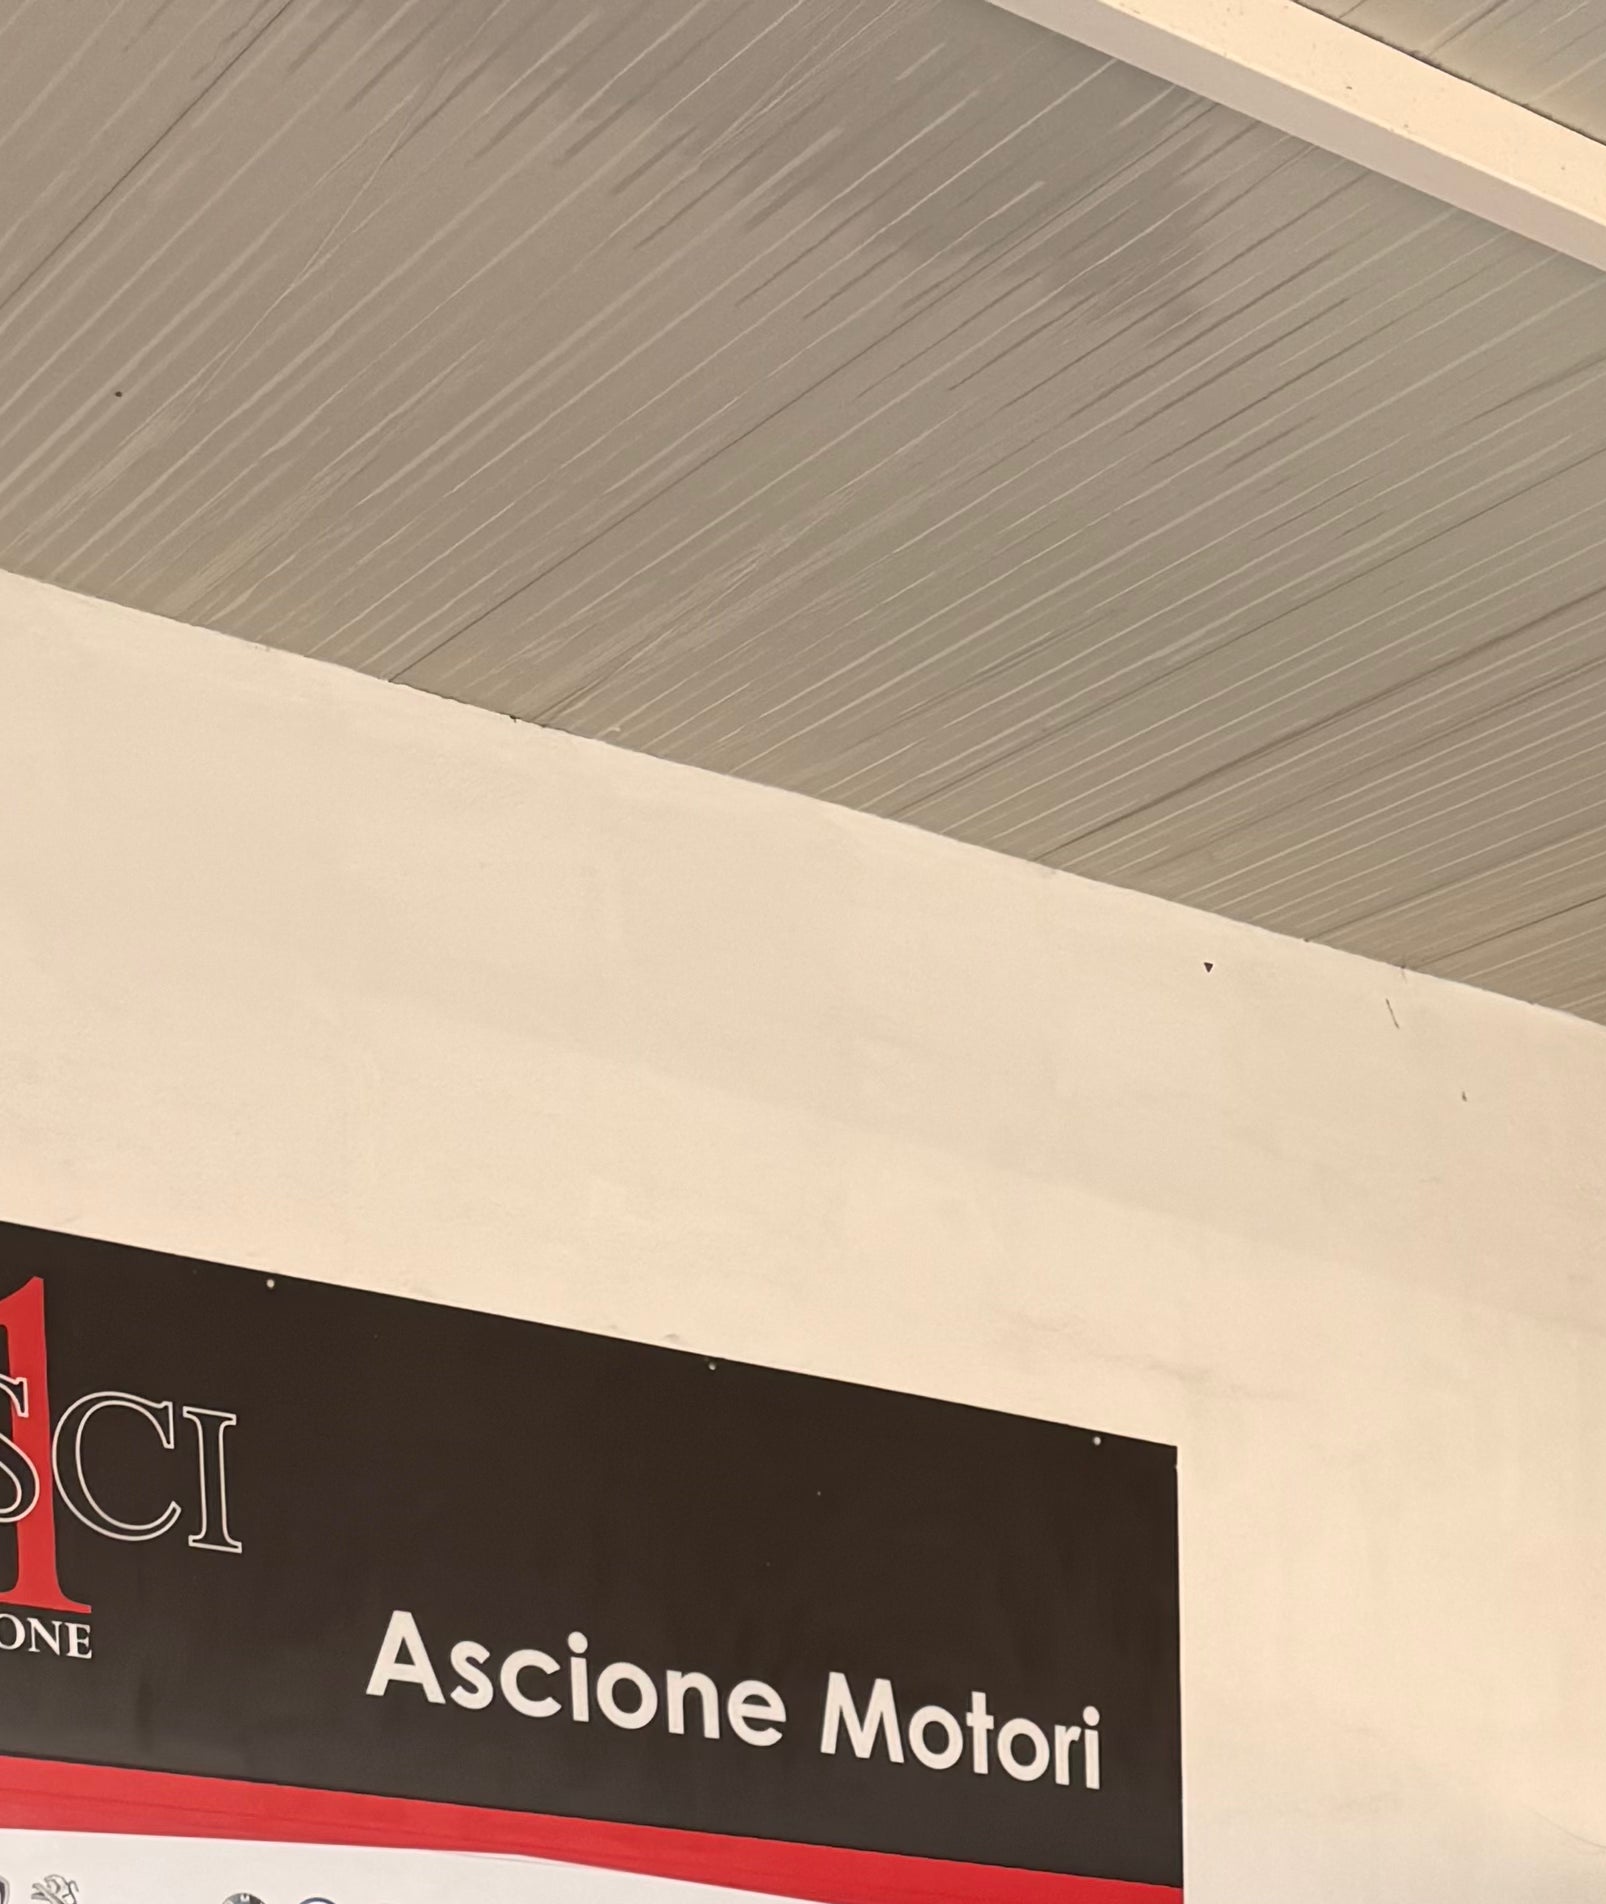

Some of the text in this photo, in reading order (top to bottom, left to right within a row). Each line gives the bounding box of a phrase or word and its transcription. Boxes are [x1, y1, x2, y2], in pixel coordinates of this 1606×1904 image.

[0, 1613, 92, 1659] ONE
[366, 1609, 1100, 1790] Ascione Motori
